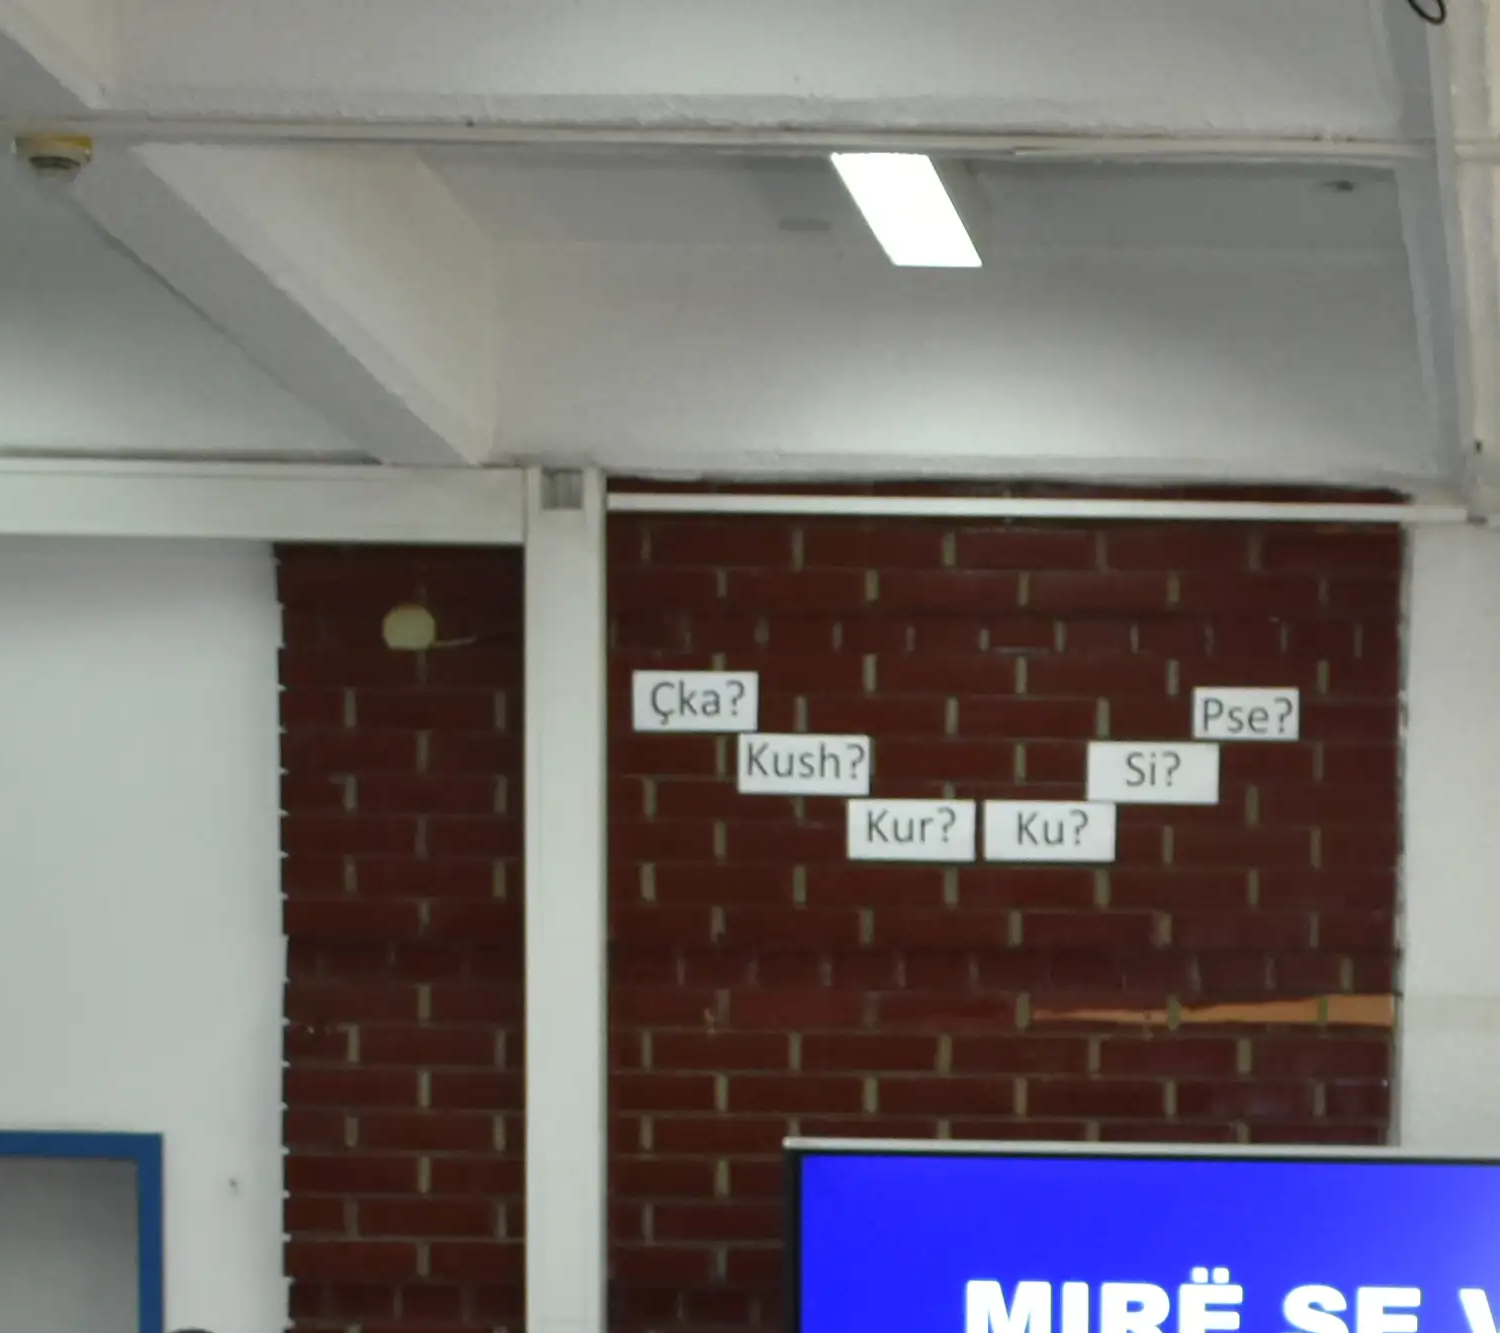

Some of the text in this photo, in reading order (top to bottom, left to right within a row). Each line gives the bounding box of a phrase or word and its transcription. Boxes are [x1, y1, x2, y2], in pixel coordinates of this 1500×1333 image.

[650, 680, 745, 725] Çka?
[1203, 698, 1294, 734] Pse?
[746, 741, 866, 779] Kush?
[1126, 751, 1181, 787] Si?
[867, 807, 956, 843] Kur?
[1017, 809, 1089, 845] Ku?
